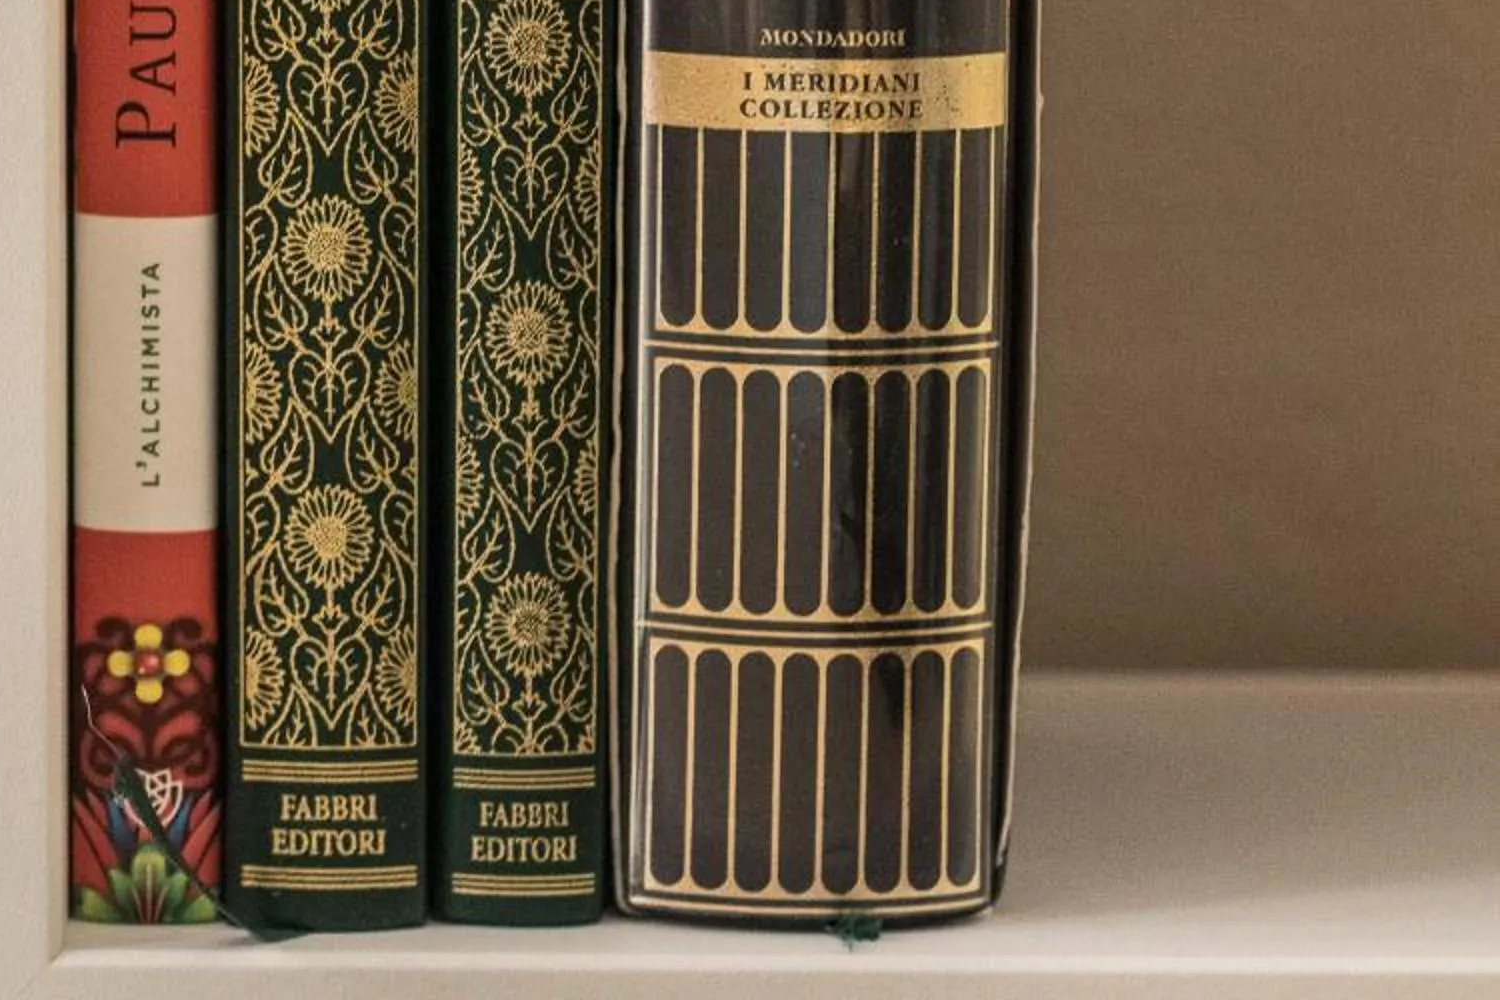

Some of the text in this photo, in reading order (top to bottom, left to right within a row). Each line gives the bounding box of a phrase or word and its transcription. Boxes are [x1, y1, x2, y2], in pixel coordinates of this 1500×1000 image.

[760, 27, 907, 49] MONDADORI
[742, 71, 921, 95] I MERIDIANI
[739, 99, 924, 121] COLLEZIONE
[136, 263, 160, 488] L'ALCHIMISTA
[280, 793, 378, 823] FABBRI
[479, 801, 570, 828] FABBRI
[271, 828, 387, 857] EDITORI
[470, 834, 578, 863] EDITORI
